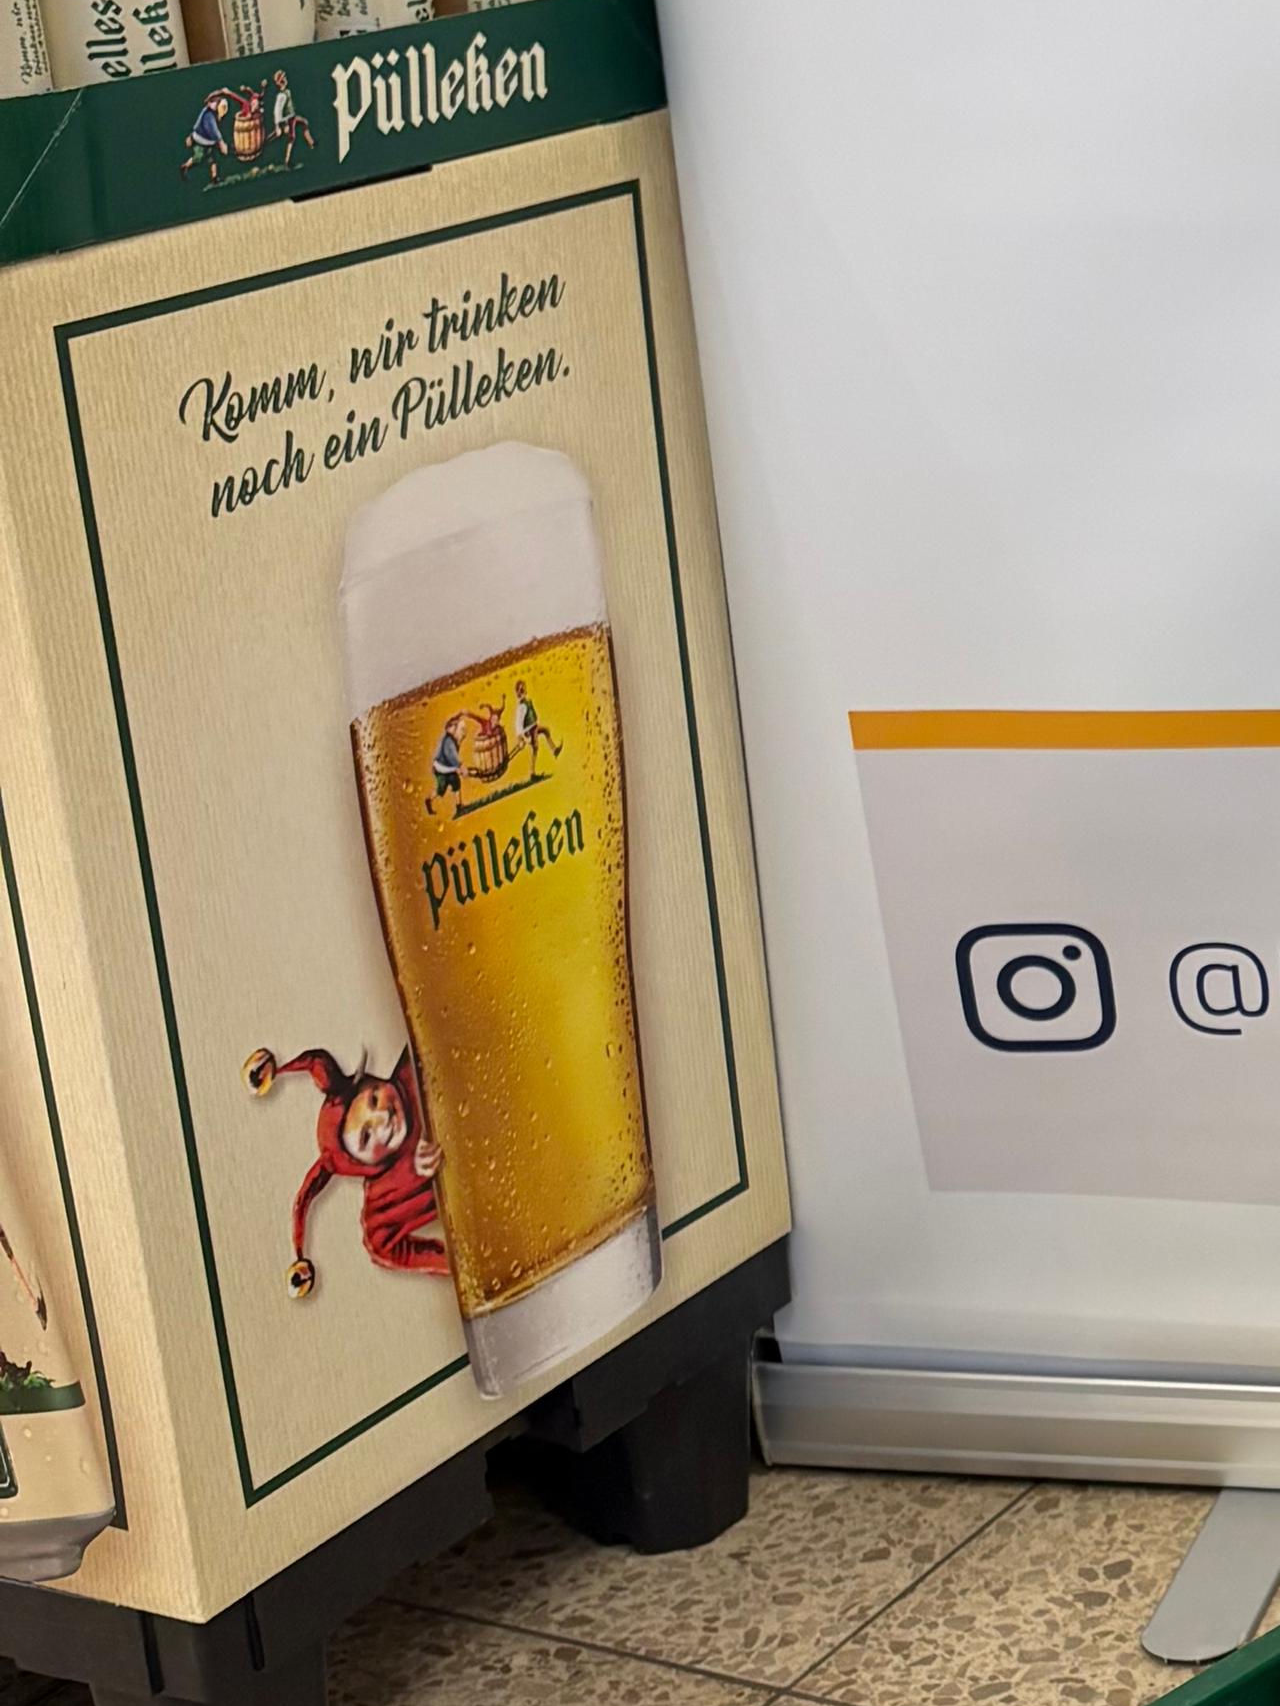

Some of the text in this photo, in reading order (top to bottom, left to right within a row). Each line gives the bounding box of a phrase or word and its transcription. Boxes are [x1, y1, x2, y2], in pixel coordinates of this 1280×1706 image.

[331, 29, 548, 164] Pülleken
[178, 271, 566, 443] Komm, wir trinken
[211, 345, 571, 519] noch ein Pülleken.
[421, 808, 585, 931] Pülleken
